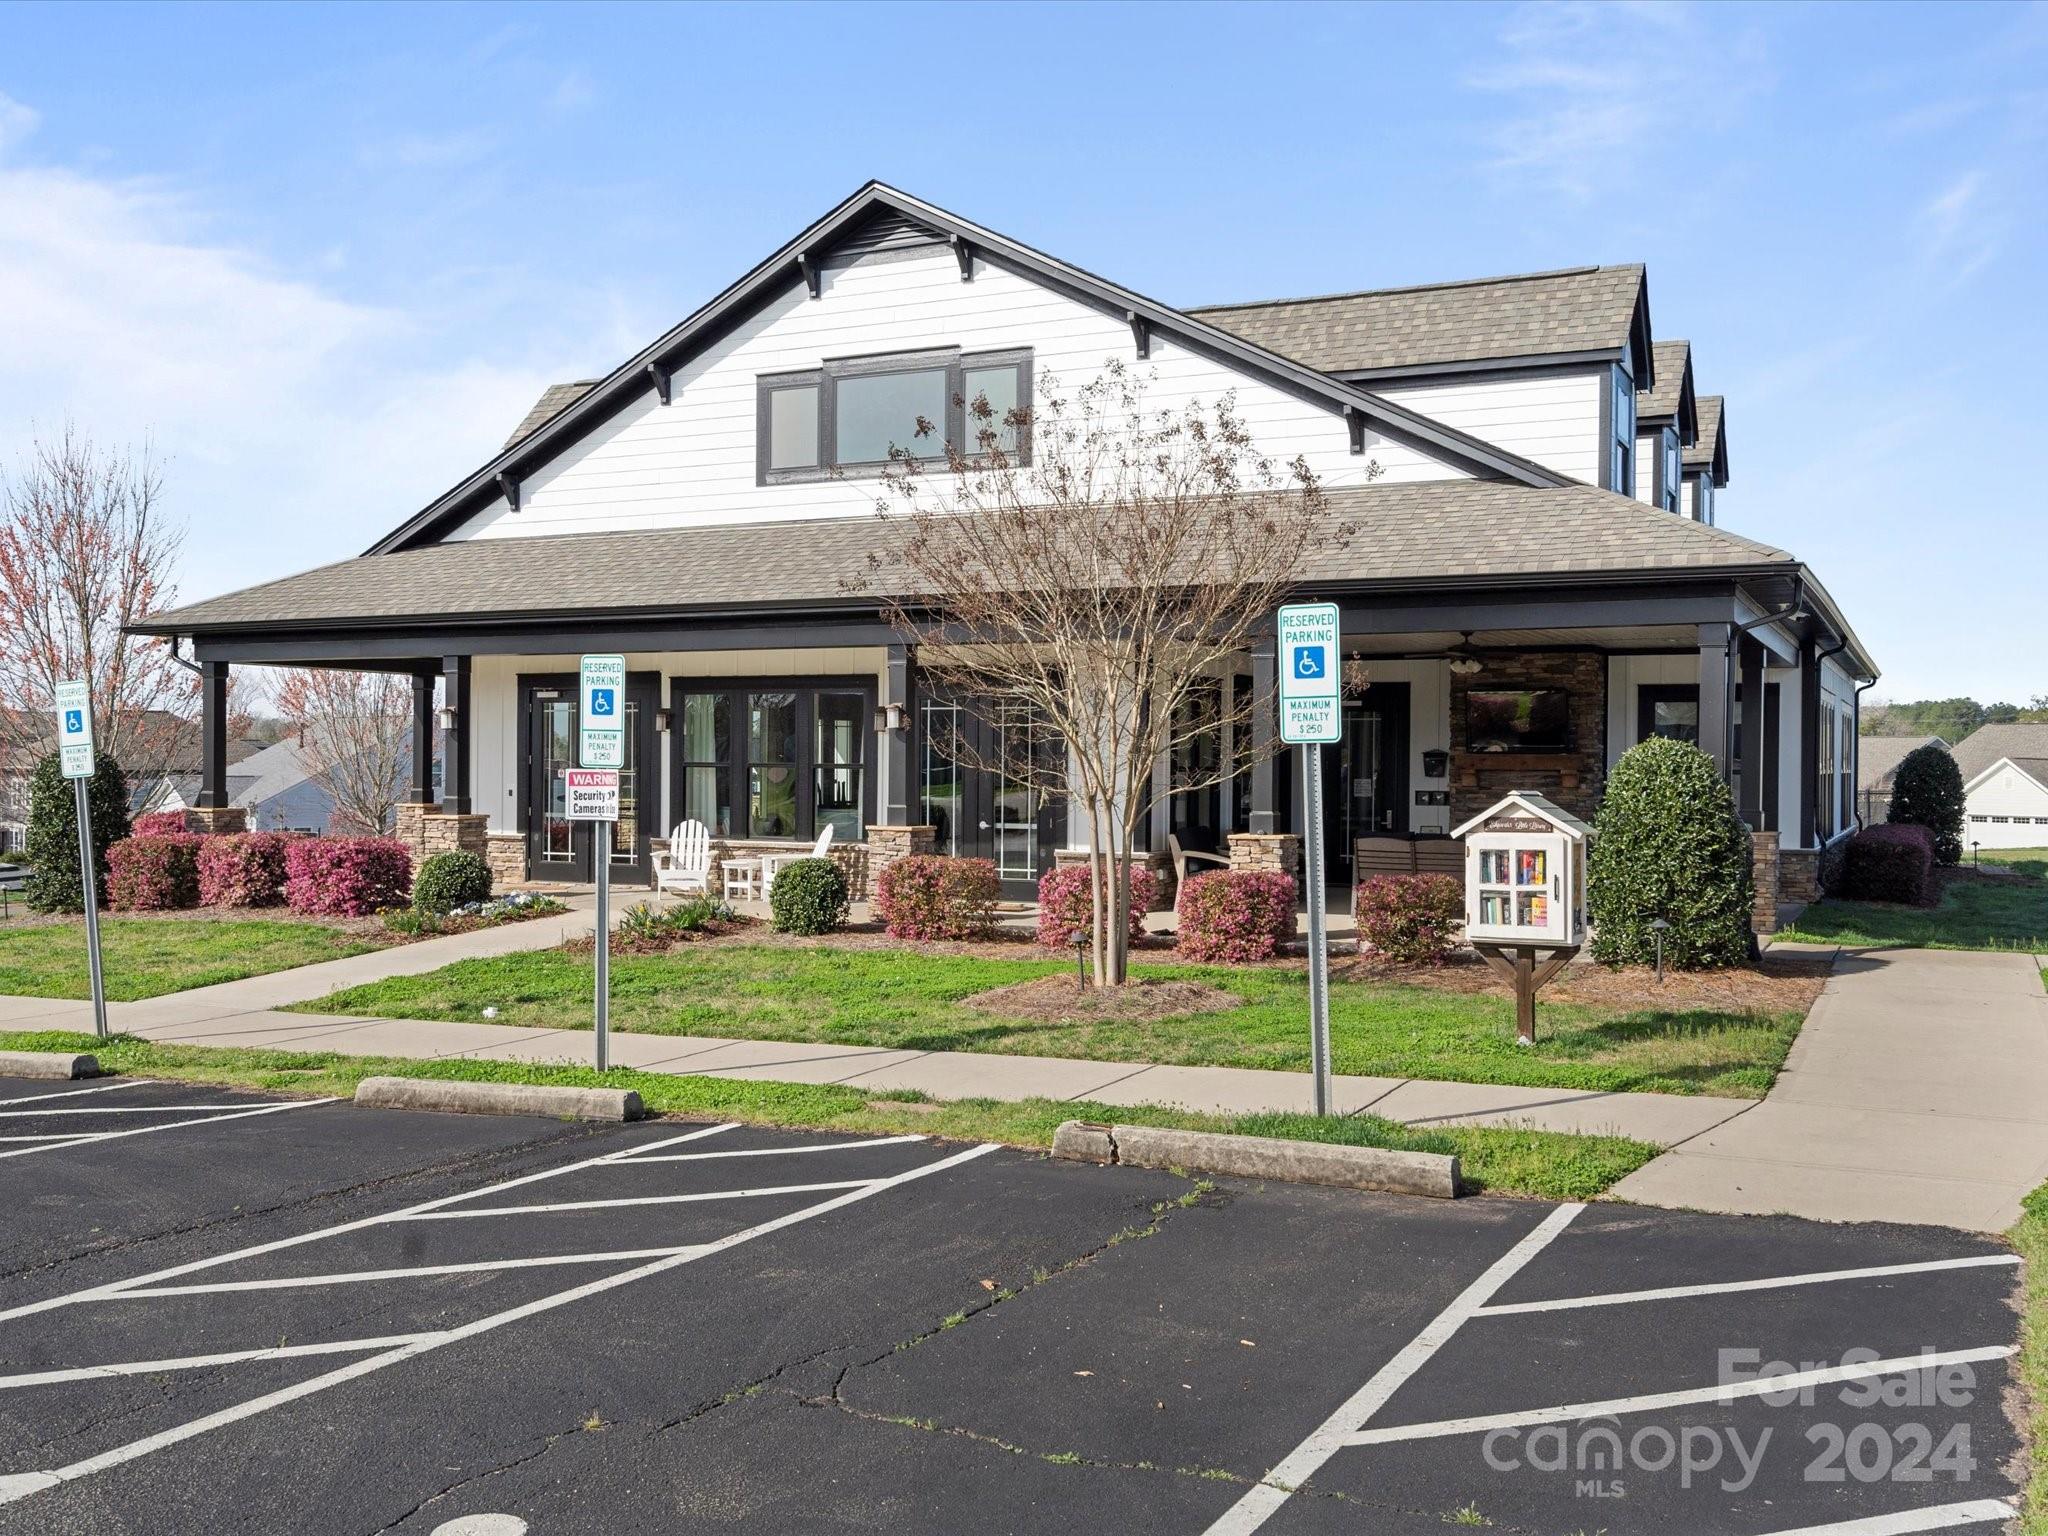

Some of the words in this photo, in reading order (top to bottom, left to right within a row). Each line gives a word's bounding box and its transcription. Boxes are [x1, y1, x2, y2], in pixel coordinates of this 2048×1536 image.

[1283, 613, 1335, 628] RESERVED
[1285, 629, 1333, 643] PARKING
[584, 662, 622, 674] RESERVED
[585, 675, 620, 686] PARKING
[1290, 700, 1331, 710] MAXIMUM
[1291, 712, 1330, 722] PENALTY
[1299, 724, 1323, 734] $250
[587, 733, 618, 741] MAXIMUM
[588, 742, 616, 751] PENALTY
[573, 790, 606, 802] Security
[573, 803, 605, 814] Cameras
